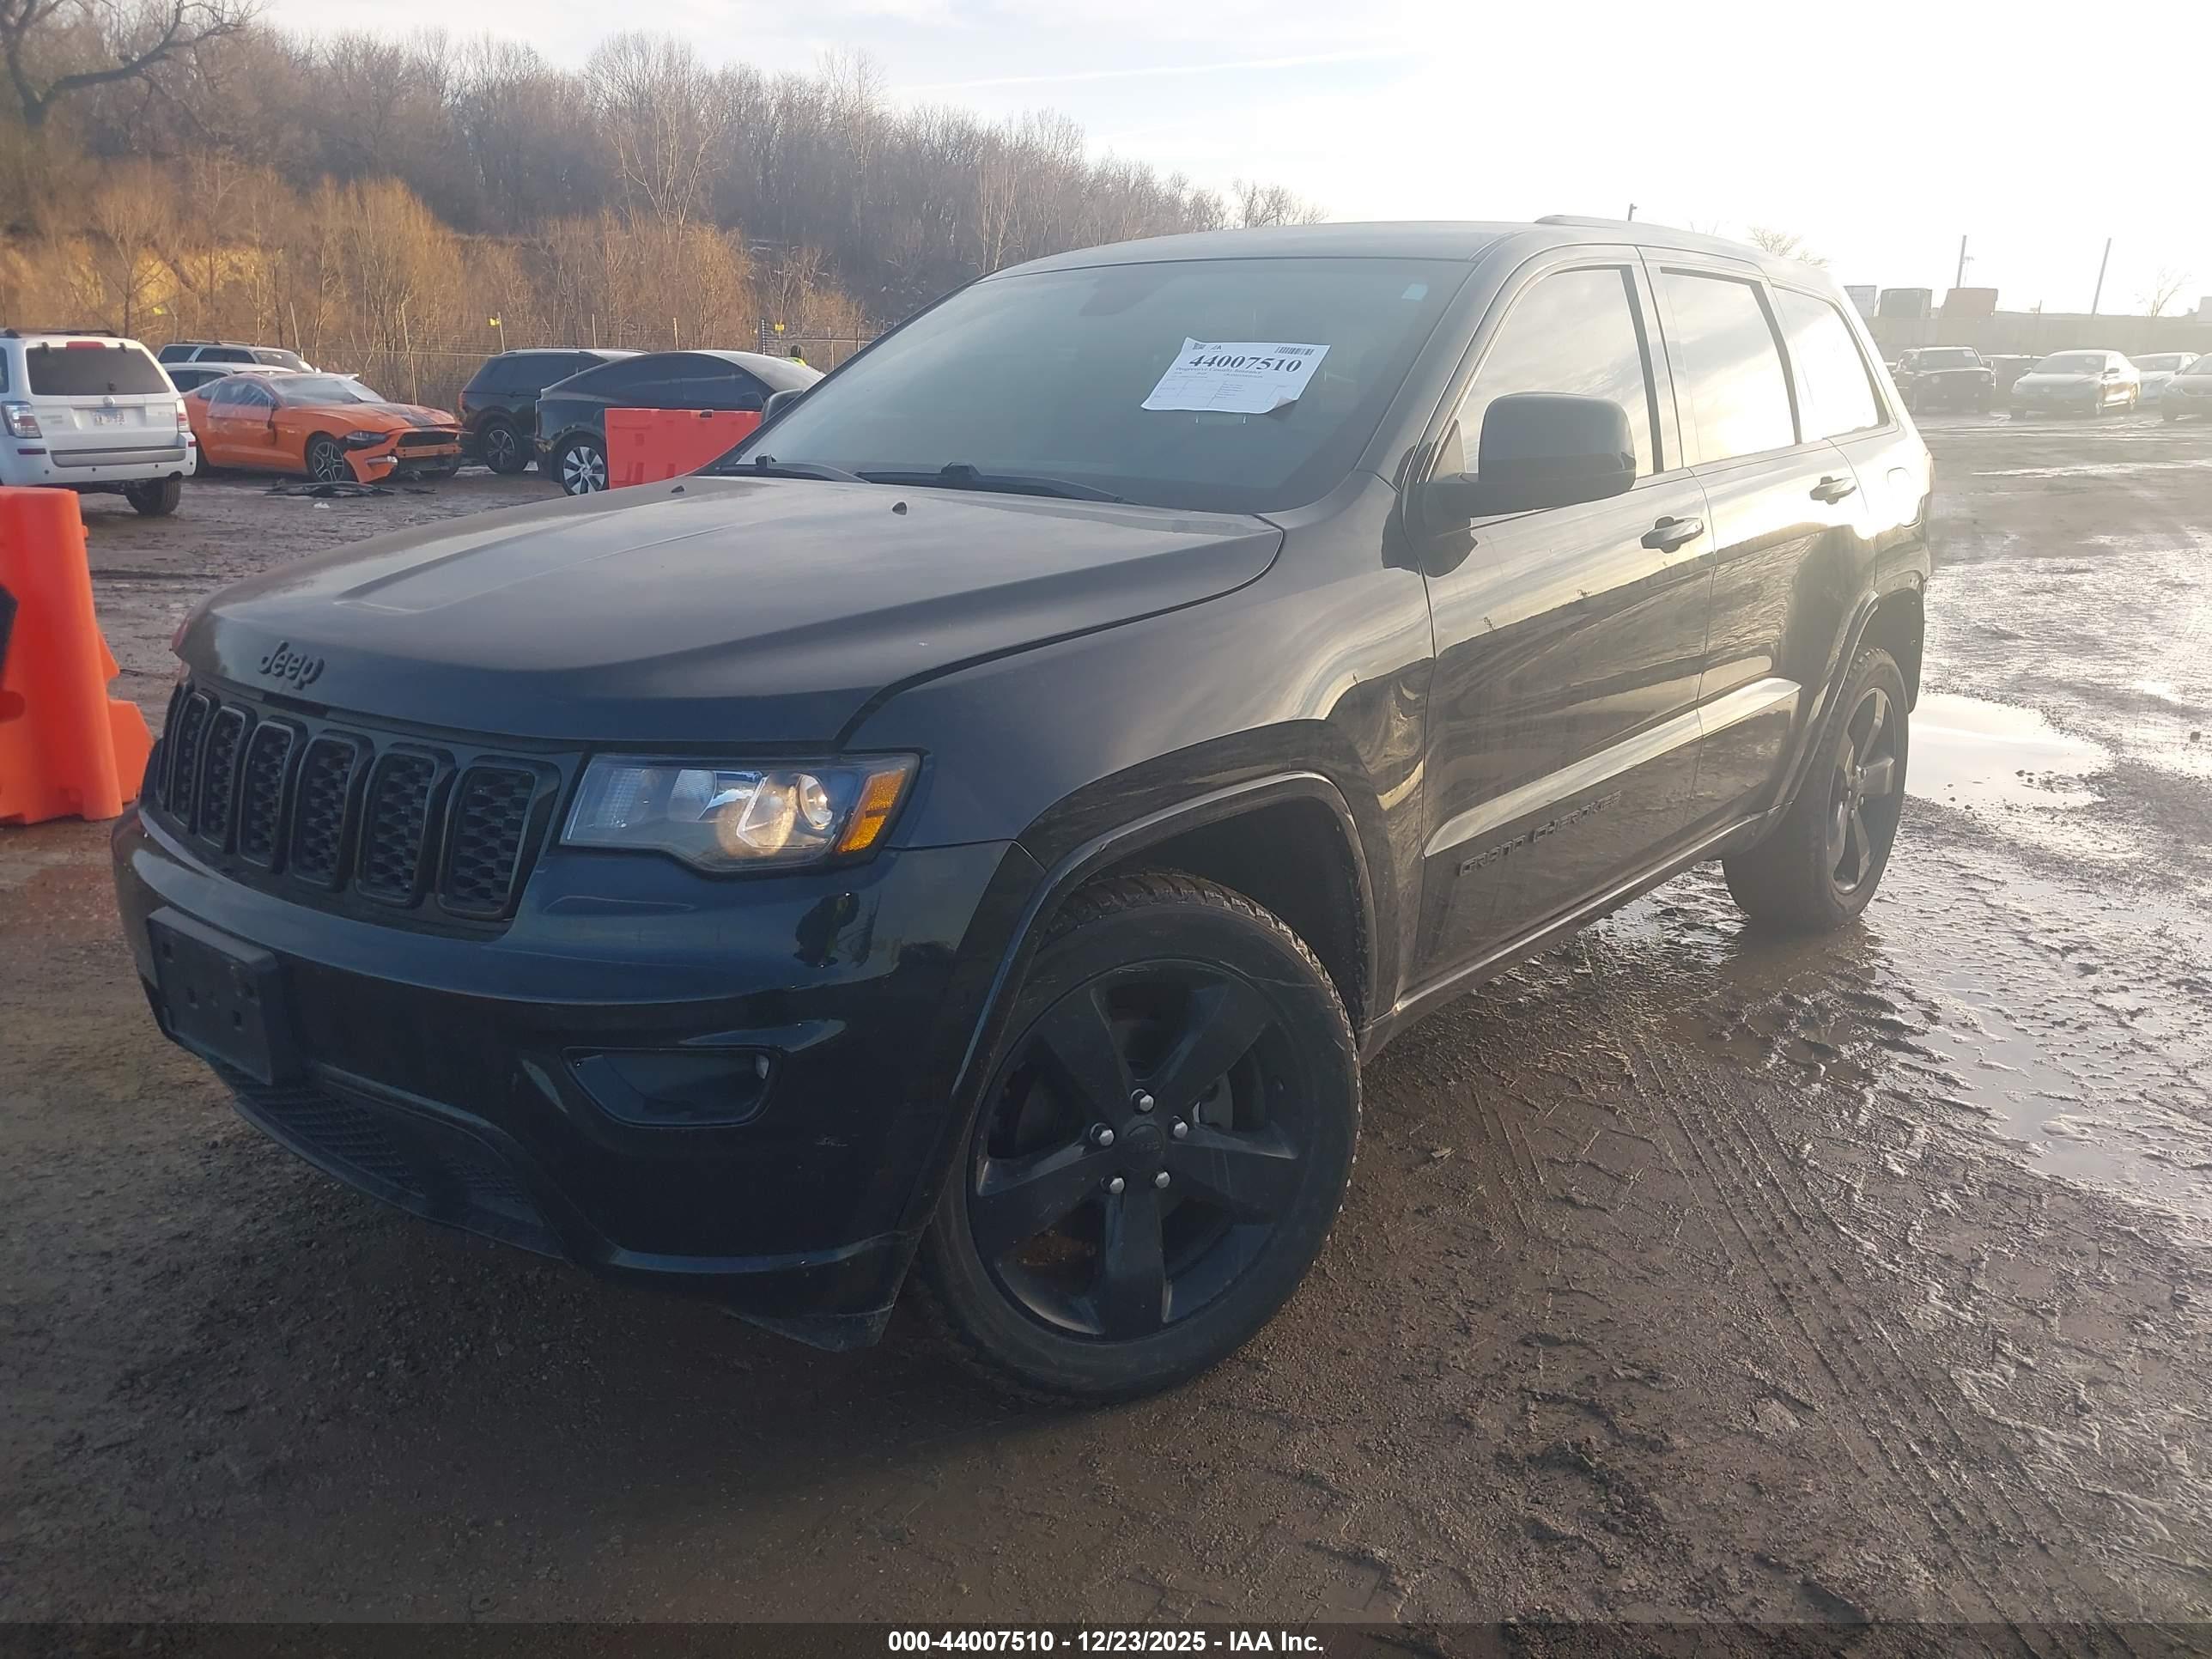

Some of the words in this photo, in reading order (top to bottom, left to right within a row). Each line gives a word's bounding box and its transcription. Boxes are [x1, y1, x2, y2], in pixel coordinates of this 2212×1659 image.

[1188, 354, 1303, 374] 44007510
[257, 641, 325, 690] Jeep
[1531, 790, 1622, 843] CHEROKEE
